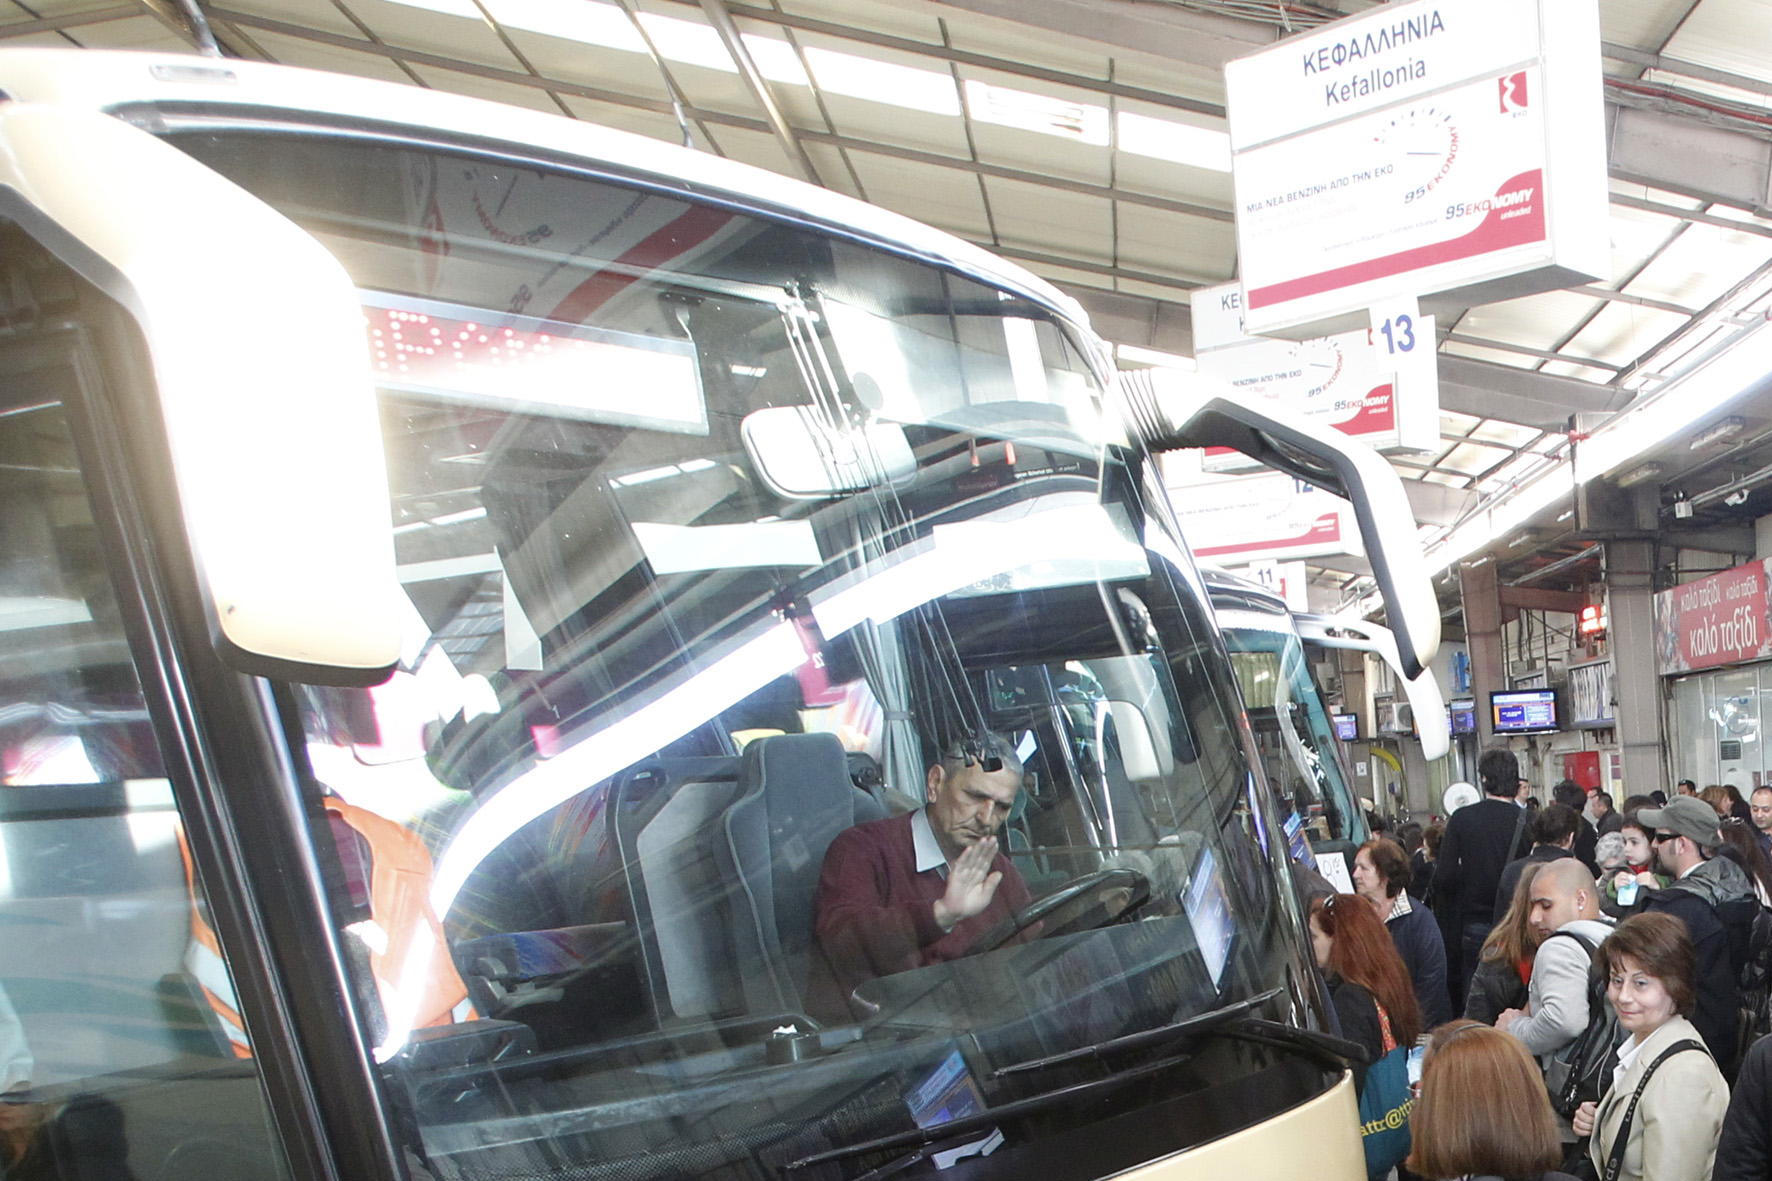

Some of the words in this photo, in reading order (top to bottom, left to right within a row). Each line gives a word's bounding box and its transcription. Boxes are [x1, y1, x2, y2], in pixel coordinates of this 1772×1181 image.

[1303, 10, 1445, 76] ΚΕΦΑΛΛΗΝΙΑ
[1326, 58, 1427, 106] Kefallonia
[1381, 314, 1415, 354] 13
[1258, 568, 1273, 584] 11
[1681, 583, 1700, 612] καλό
[1699, 577, 1721, 611] ταξίδι
[1726, 583, 1741, 600] καλό
[1740, 575, 1759, 600] ταξίδι
[1690, 613, 1718, 658] καλό
[1721, 605, 1758, 658] ταξίδι
